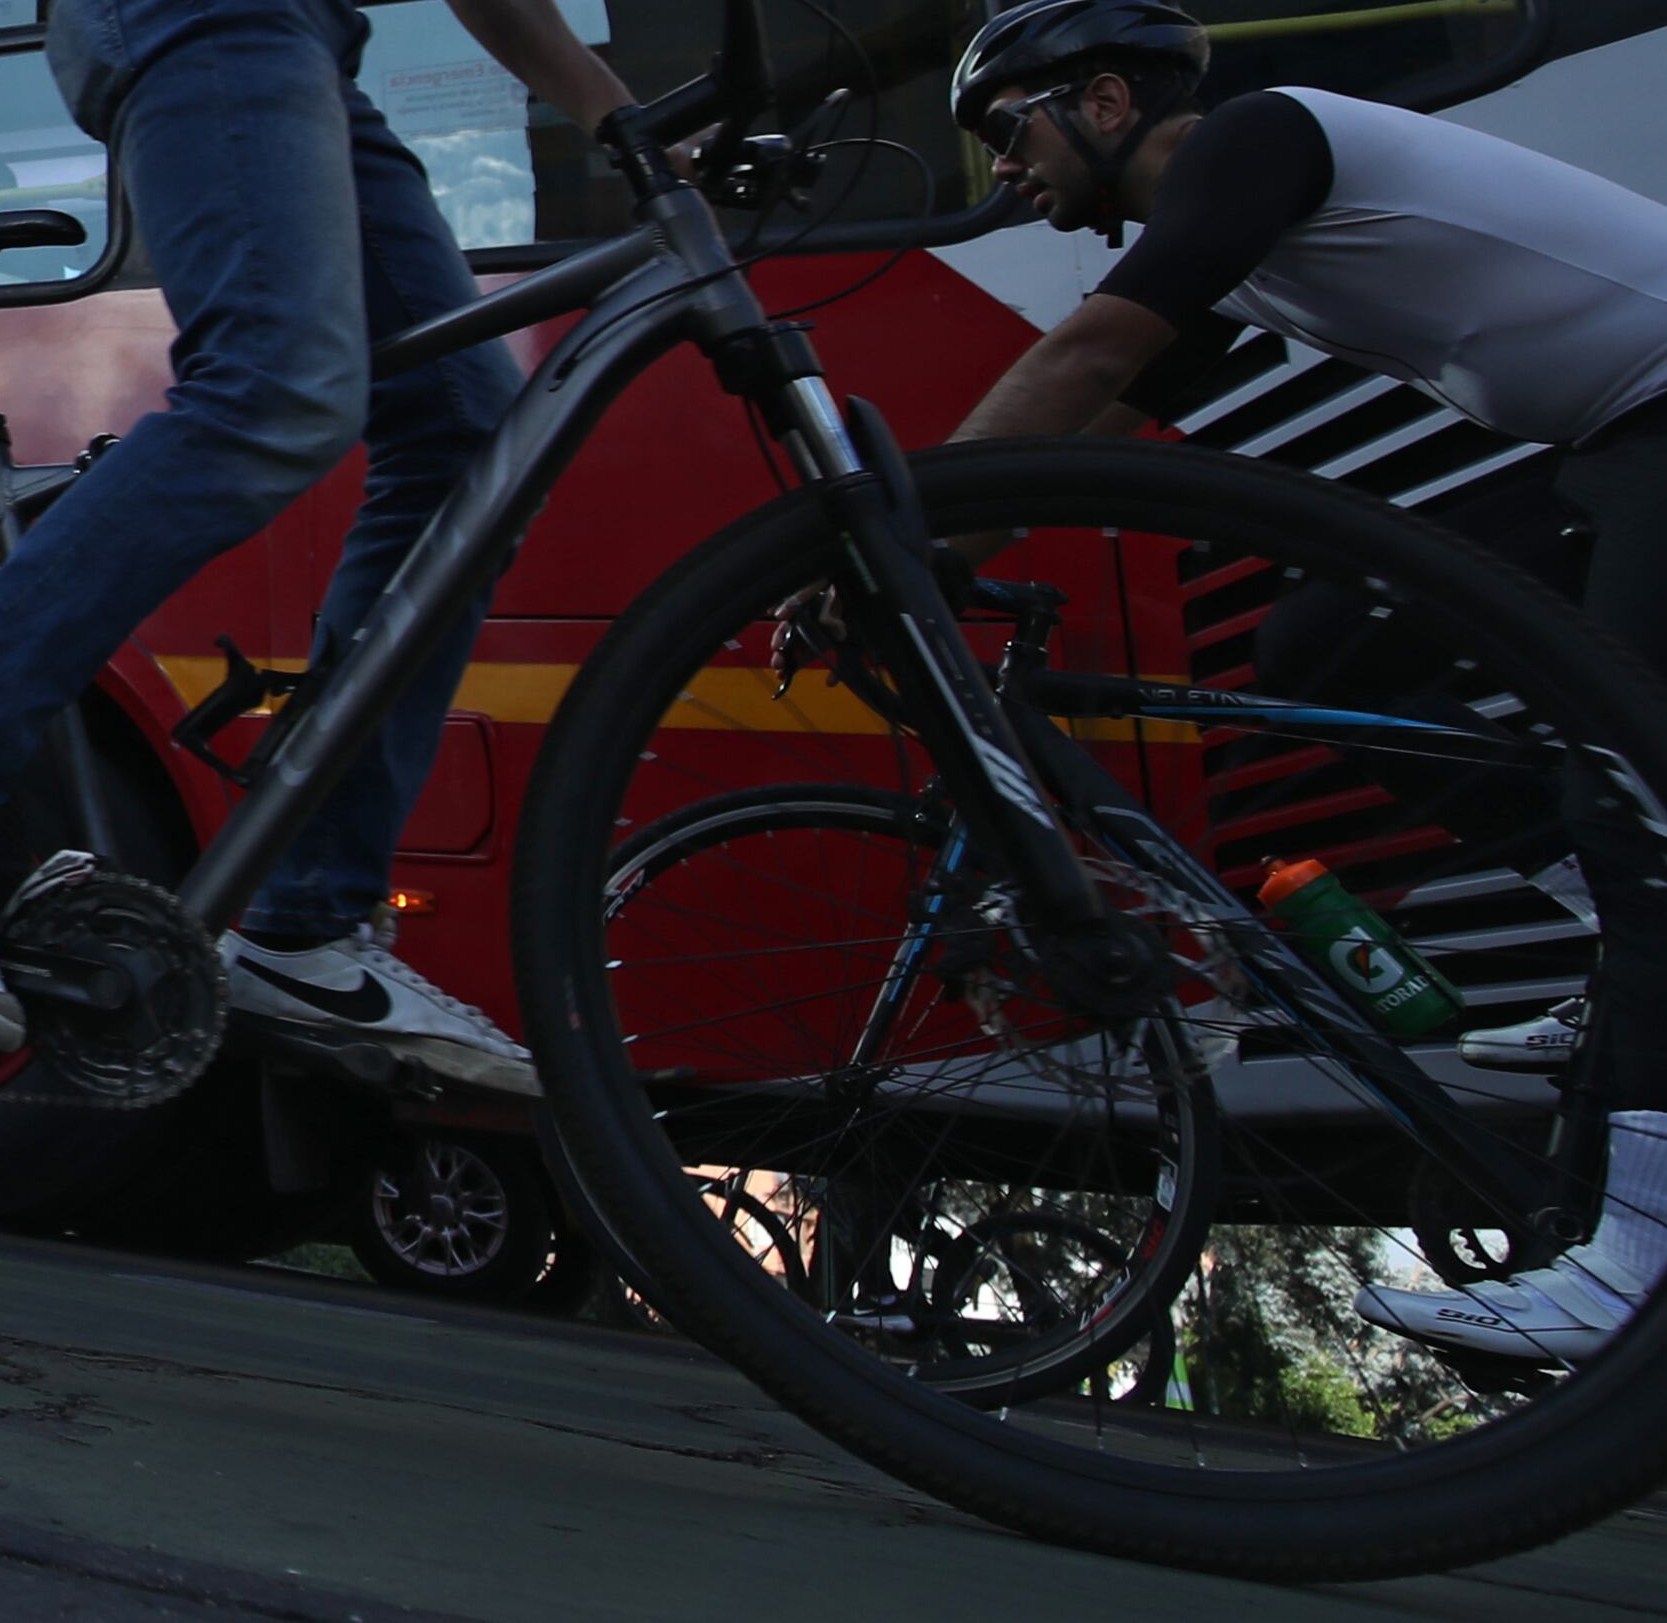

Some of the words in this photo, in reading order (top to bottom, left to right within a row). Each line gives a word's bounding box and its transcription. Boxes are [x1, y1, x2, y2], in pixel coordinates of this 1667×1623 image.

[1329, 925, 1405, 994] G
[1525, 1032, 1576, 1048] SID
[1436, 1308, 1504, 1327] SID
